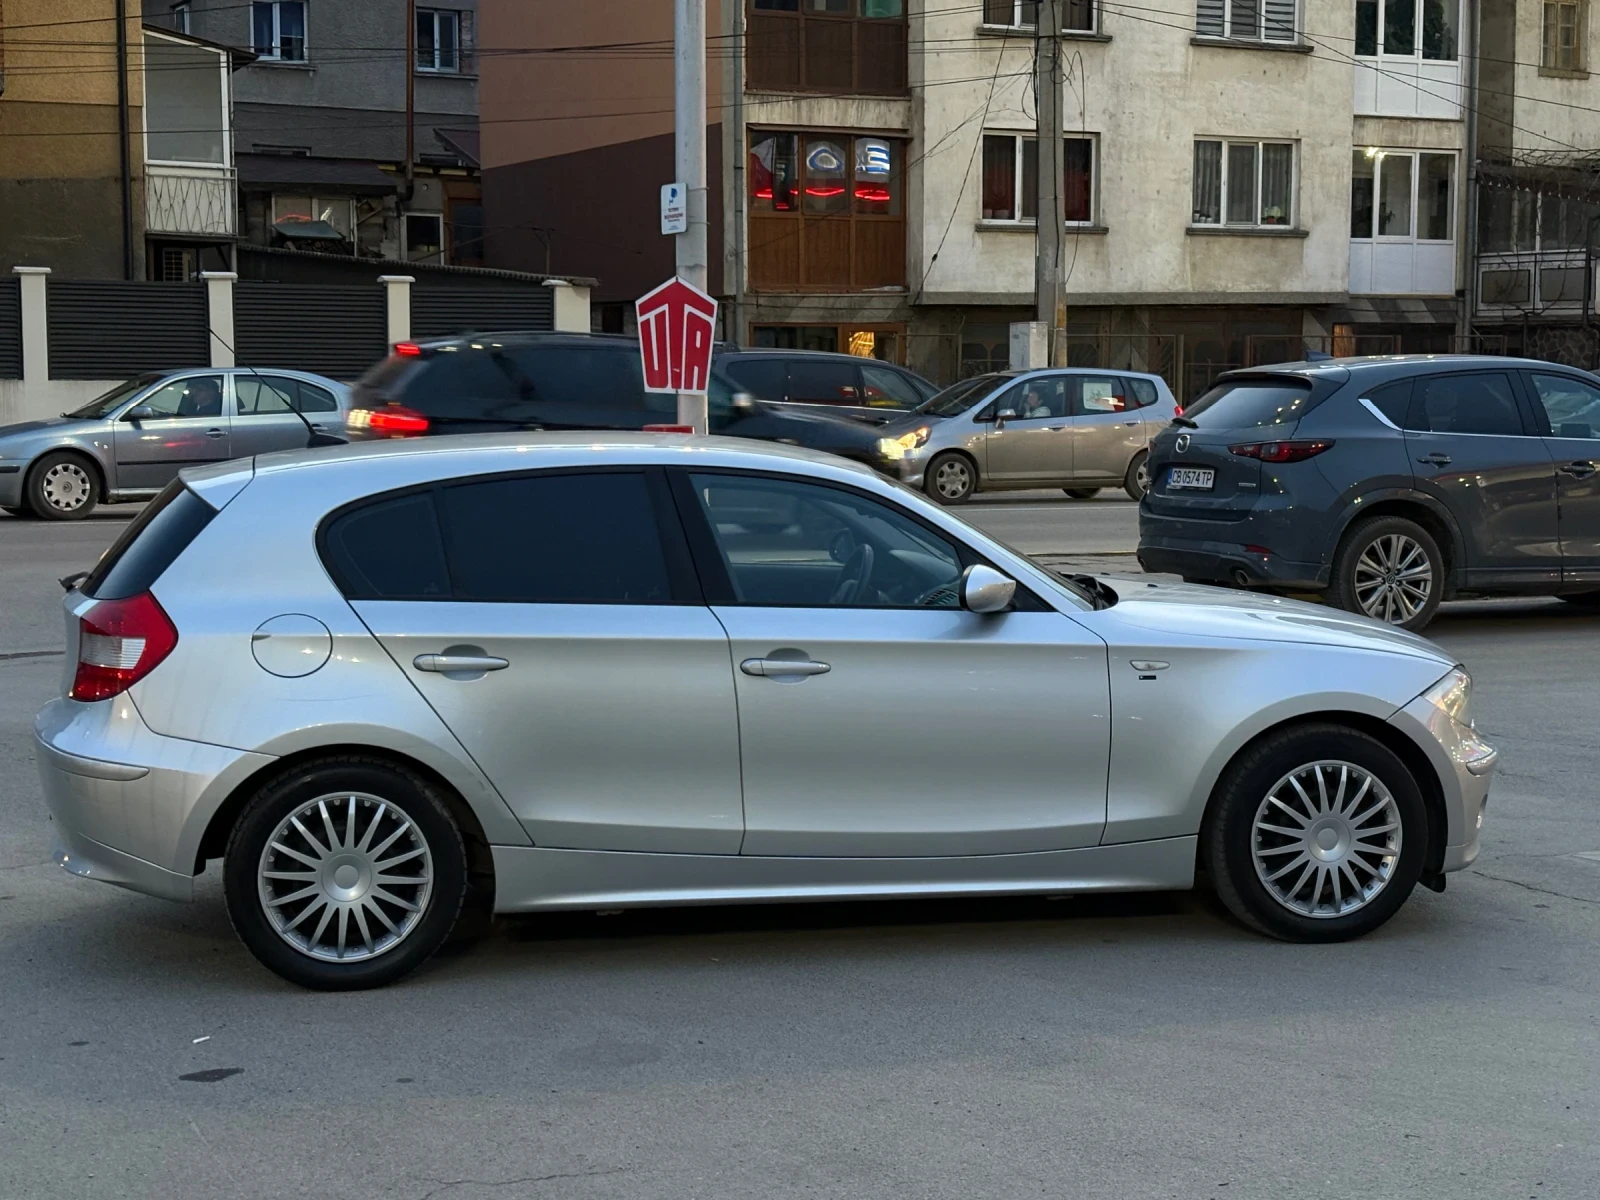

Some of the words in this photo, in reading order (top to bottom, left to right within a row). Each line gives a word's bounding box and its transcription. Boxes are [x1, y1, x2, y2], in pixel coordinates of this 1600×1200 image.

[1172, 470, 1181, 483] CB
[1182, 471, 1200, 484] 0574
[1202, 472, 1212, 485] TP
